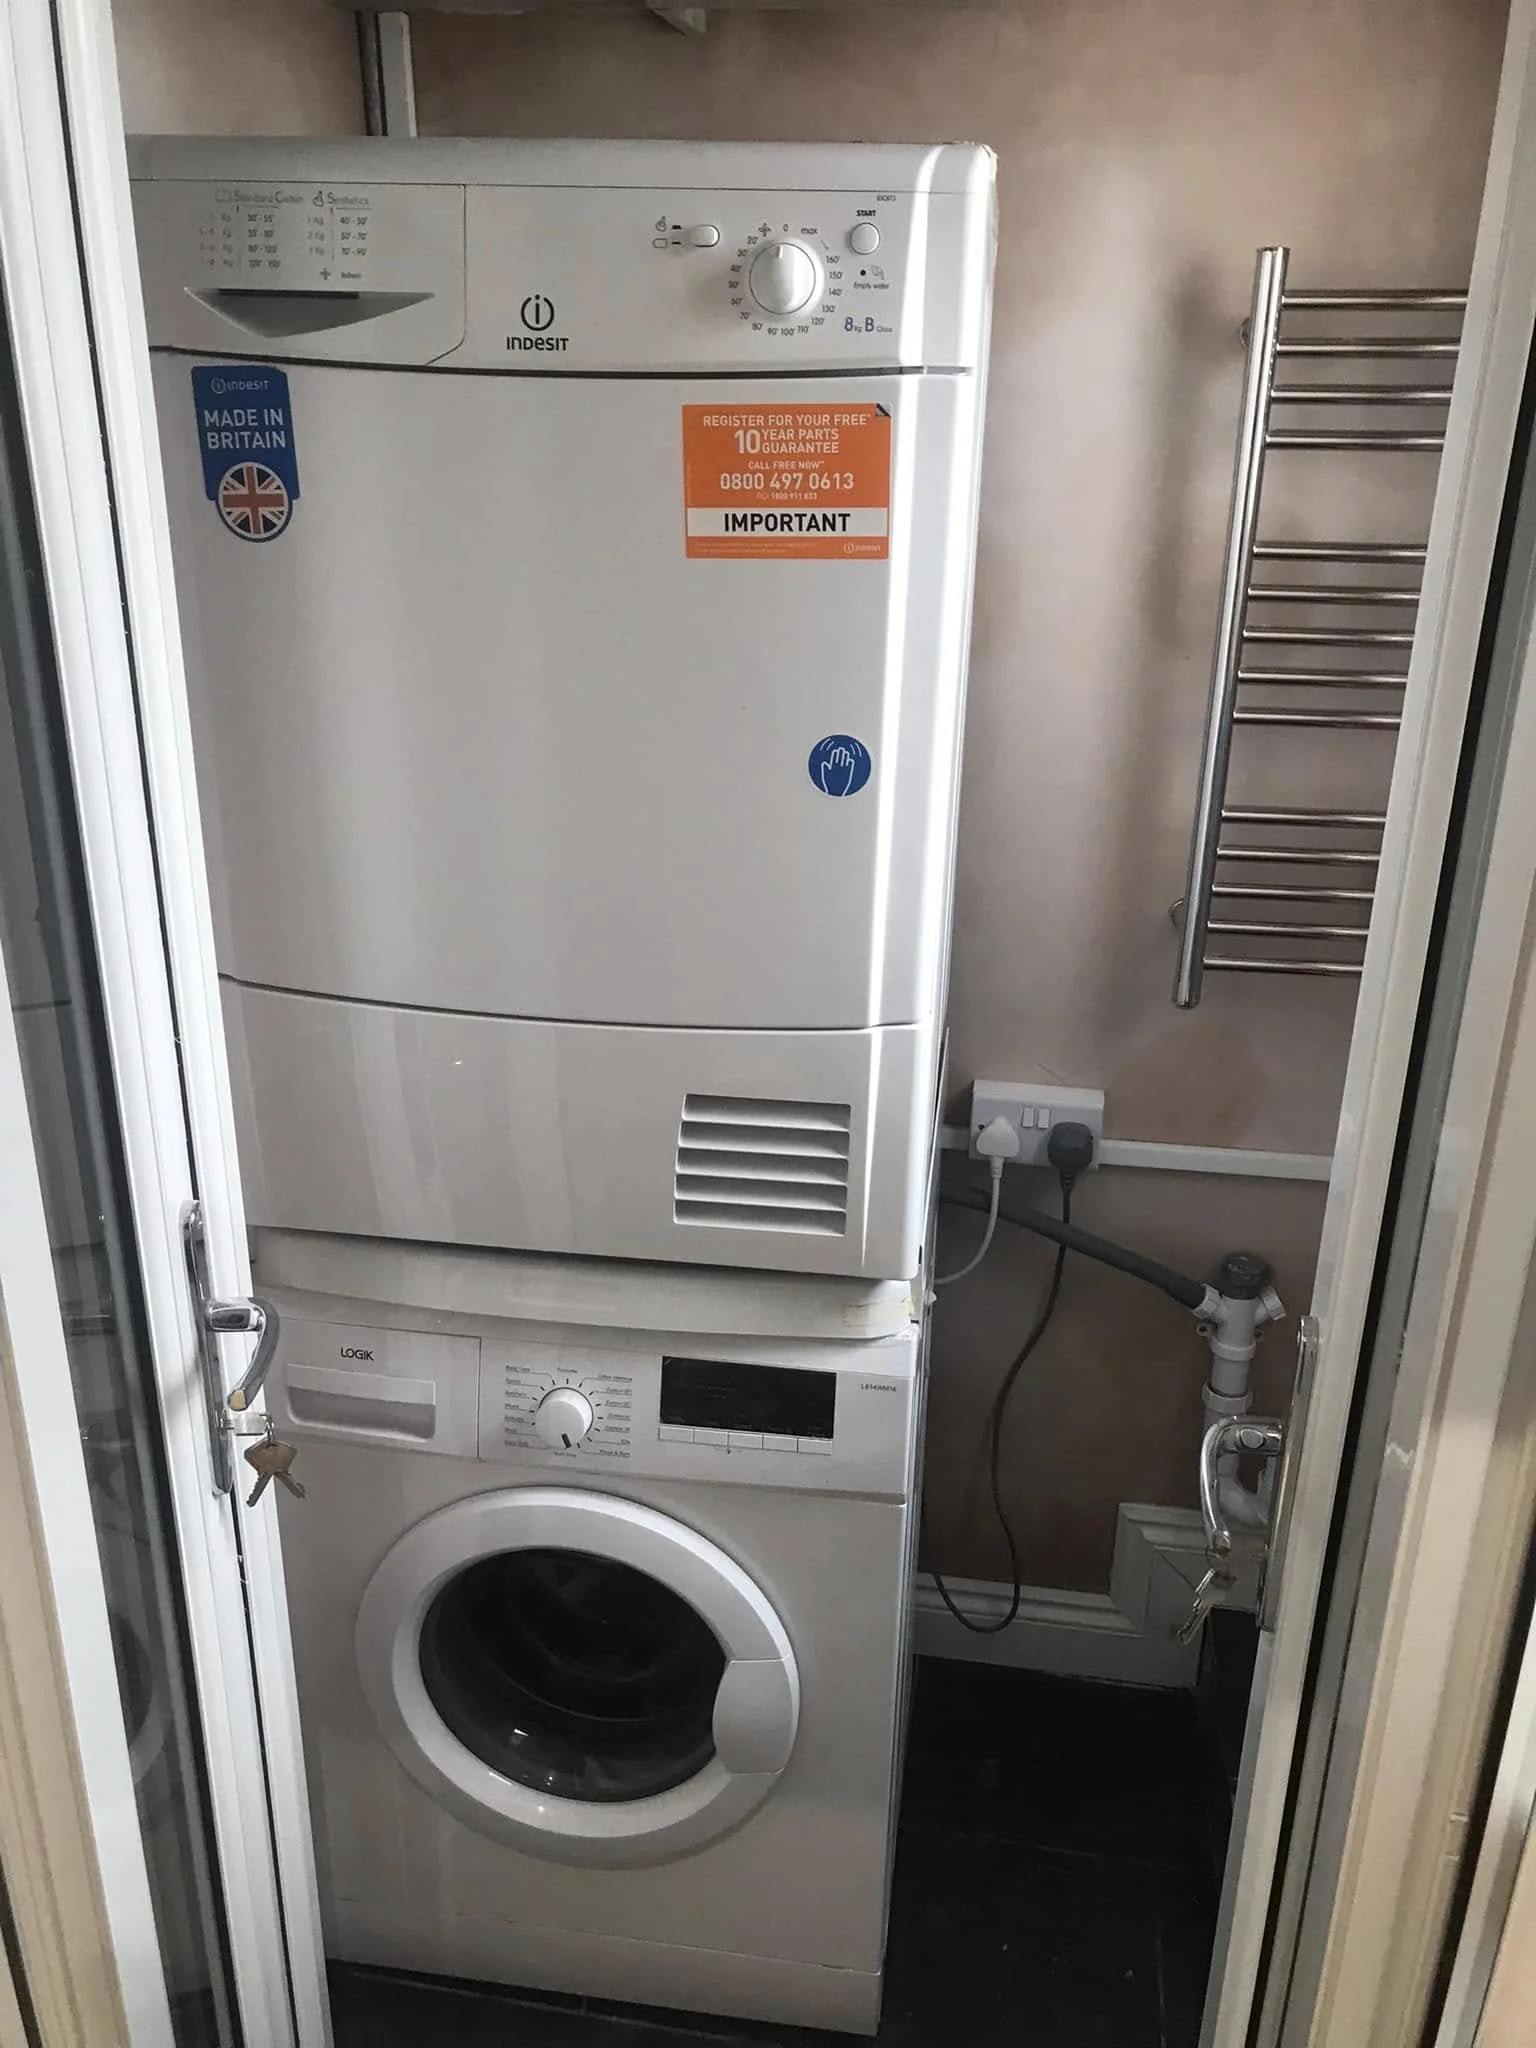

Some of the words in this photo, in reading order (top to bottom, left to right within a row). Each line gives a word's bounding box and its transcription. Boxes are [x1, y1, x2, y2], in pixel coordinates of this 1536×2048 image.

[856, 209, 876, 217] START
[782, 223, 789, 232] 0
[800, 227, 818, 235] max
[844, 316, 854, 332] 8
[865, 316, 875, 332] B
[203, 408, 258, 427] MADE
[263, 408, 284, 426] IN
[703, 415, 765, 427] REGISTER
[768, 415, 793, 426] FOR
[797, 415, 831, 426] YOUR
[207, 431, 287, 449] BRITAIN
[734, 429, 761, 454] 10
[762, 428, 795, 440] YEAR
[798, 428, 839, 440] PARTS
[762, 442, 839, 454] GUARANTEE
[748, 461, 770, 470] CALL
[773, 461, 797, 470] FREE
[720, 473, 764, 490] 0800
[770, 472, 803, 490] 497
[808, 472, 854, 490] 0613
[724, 513, 850, 532] IMPORTANT
[340, 1347, 374, 1361] LOGIK
